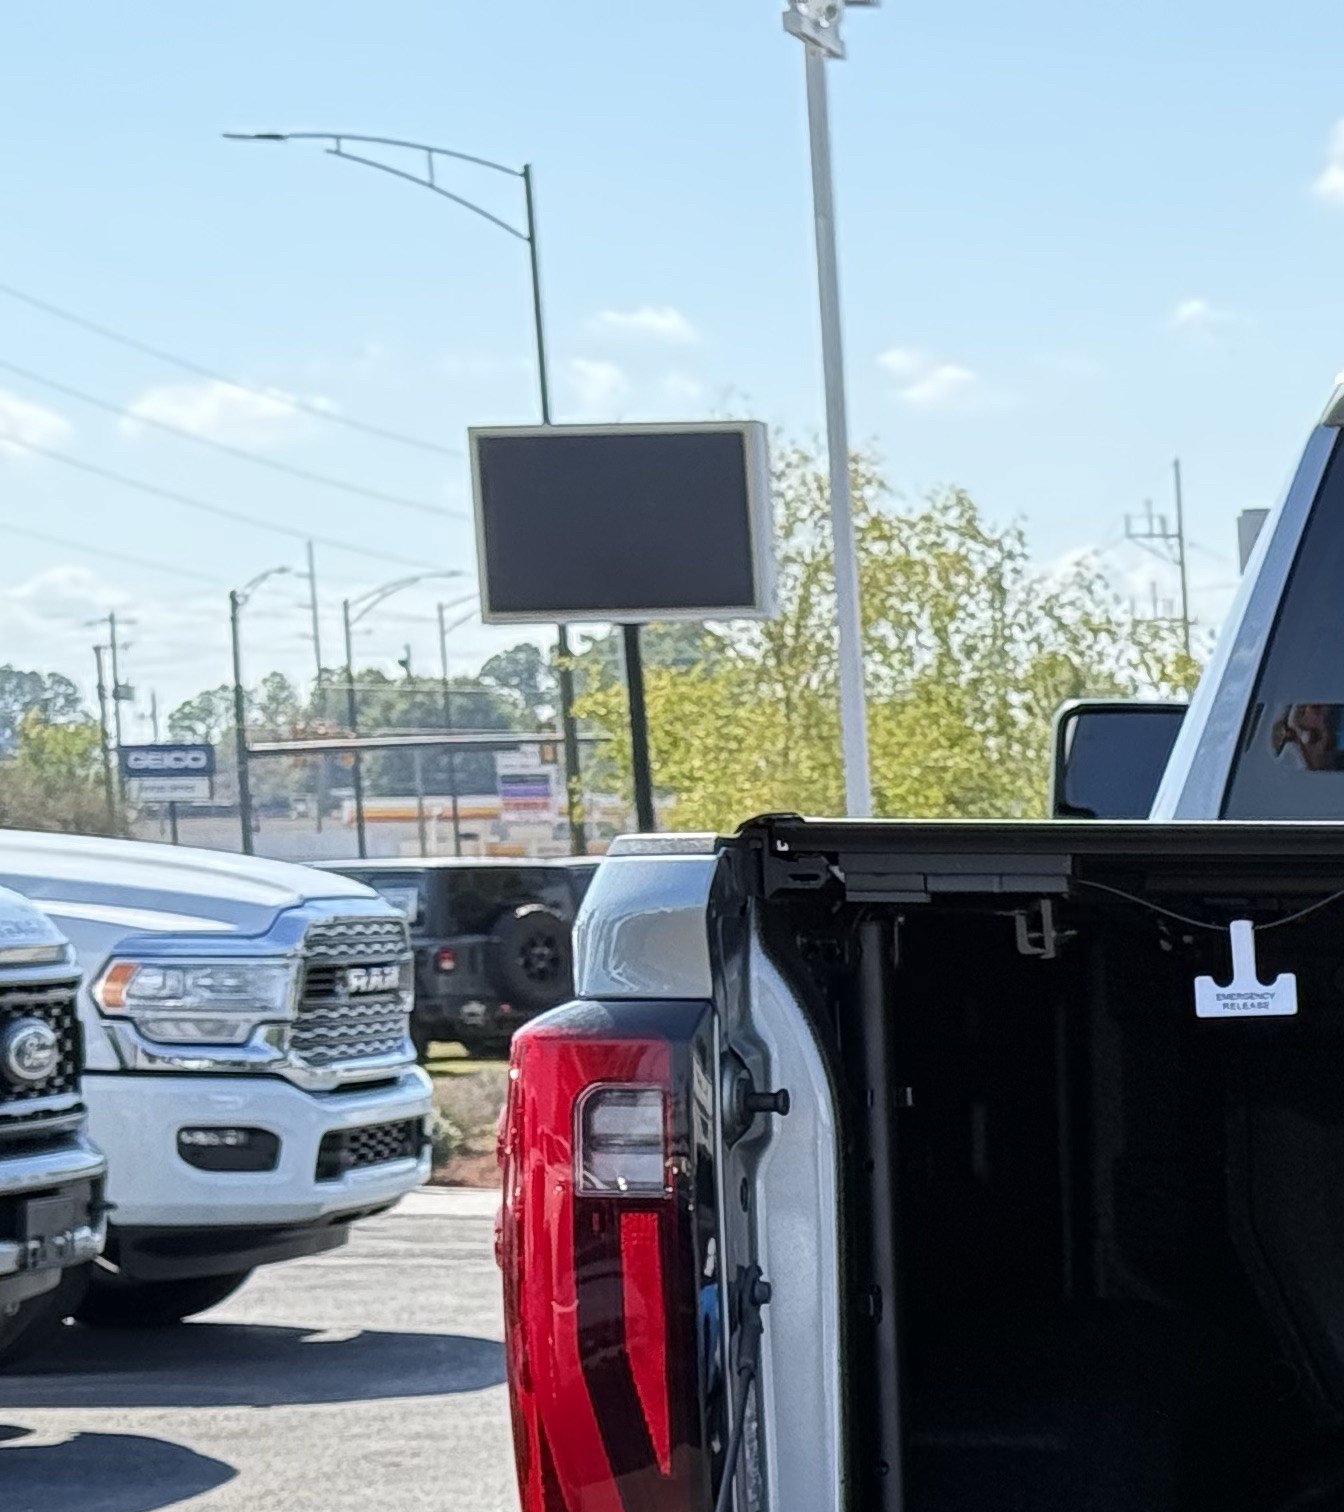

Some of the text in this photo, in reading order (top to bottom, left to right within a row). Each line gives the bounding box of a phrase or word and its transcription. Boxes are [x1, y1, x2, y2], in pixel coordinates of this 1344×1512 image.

[127, 750, 208, 770] GEICO
[1215, 991, 1276, 1002] EMERGENCY
[1222, 1001, 1270, 1011] RELEASE
